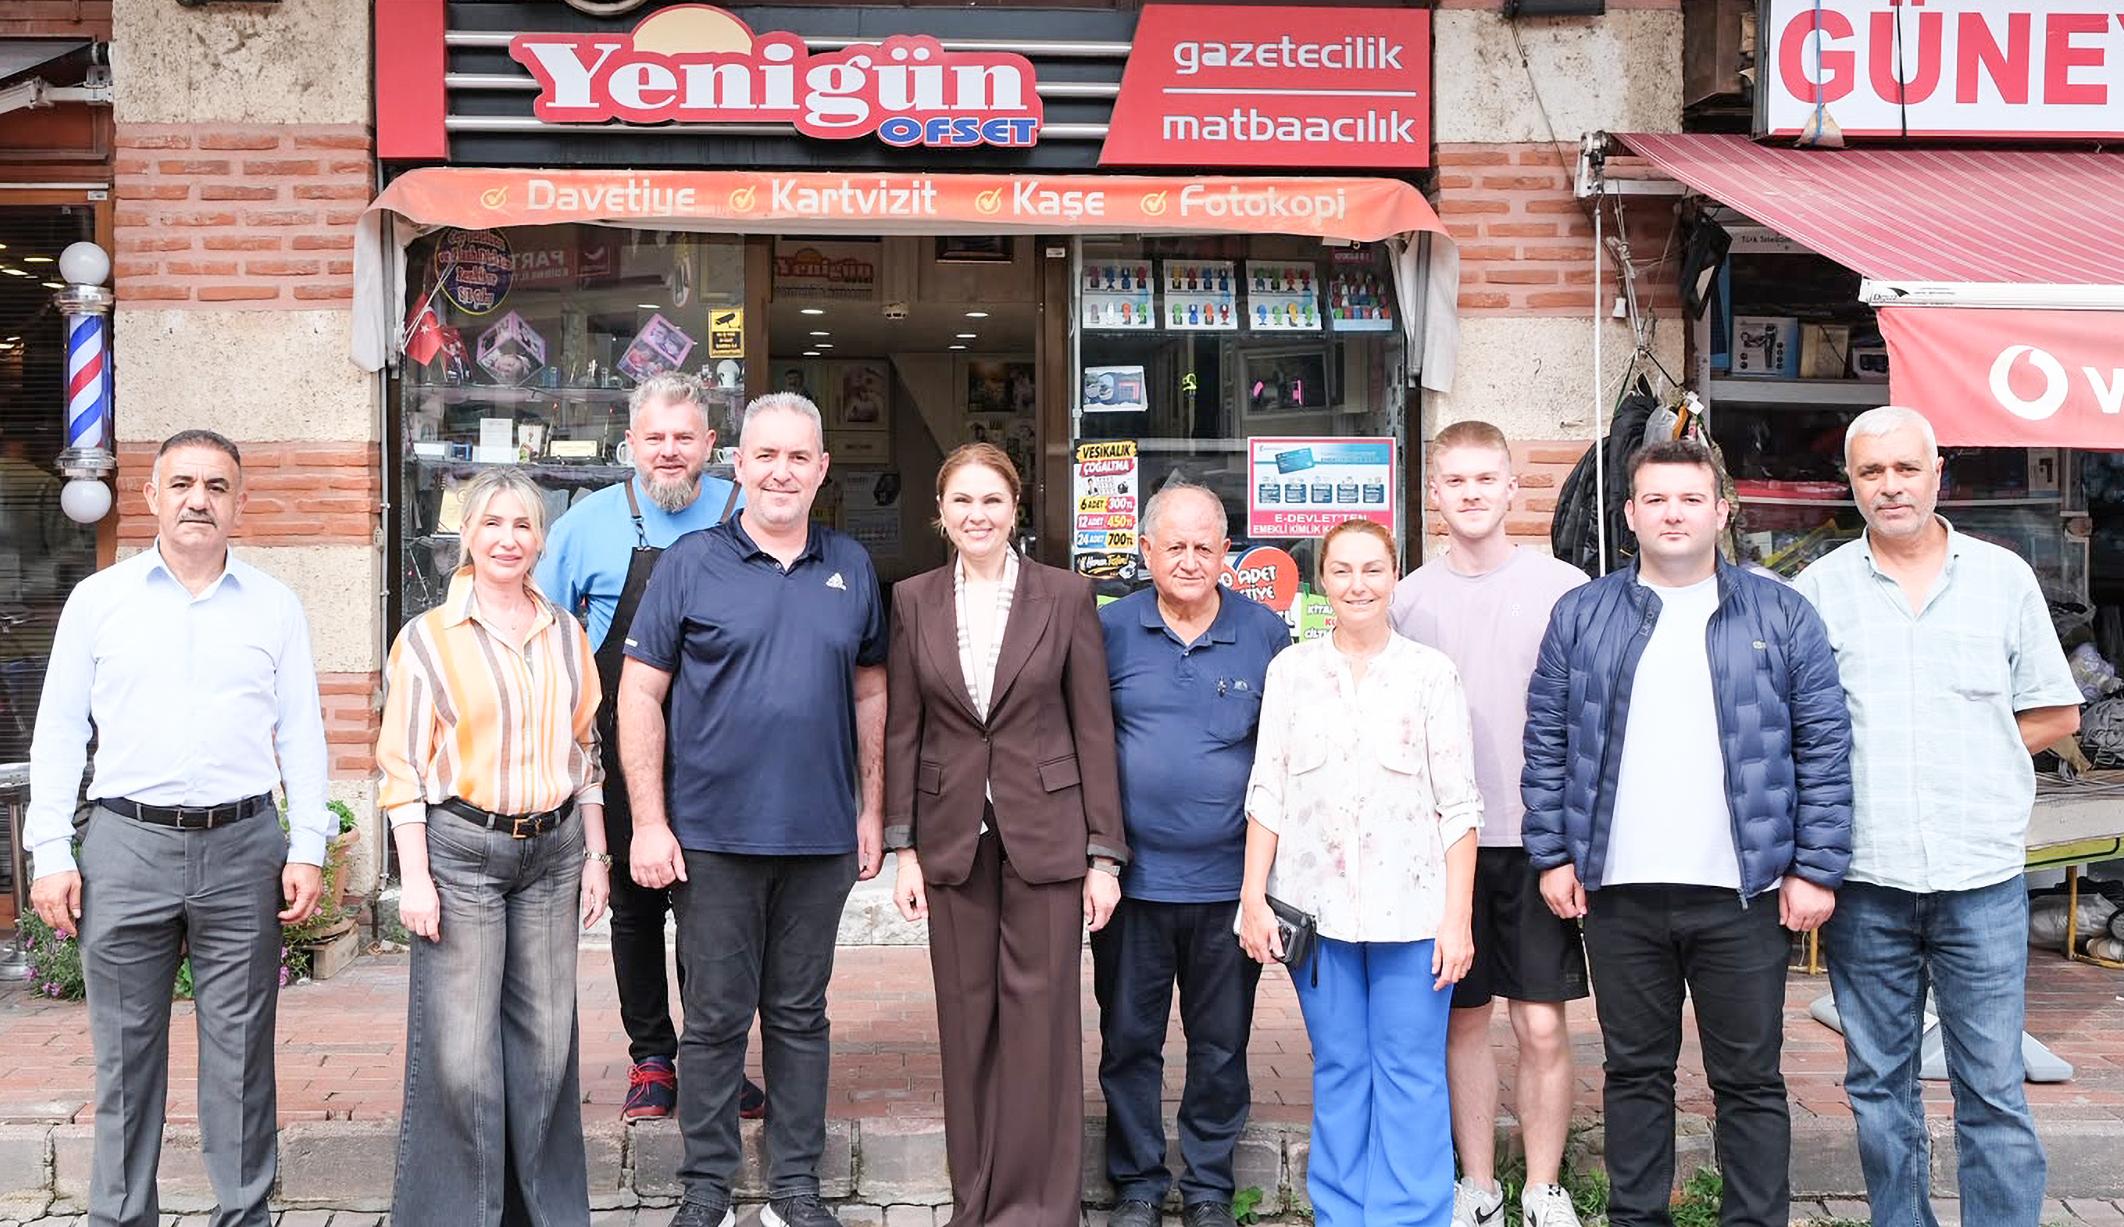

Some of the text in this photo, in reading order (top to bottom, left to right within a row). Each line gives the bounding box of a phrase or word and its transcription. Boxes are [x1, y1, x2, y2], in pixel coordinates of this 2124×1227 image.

[1173, 35, 1404, 75] gazetecilik
[1778, 0, 2124, 105] GÜNE
[522, 43, 1028, 128] Yenigün
[879, 117, 1038, 145] OFSET
[1162, 108, 1416, 144] matbaacılık
[528, 177, 1344, 221] Davetiye Kartvizit Kaşe Fotokopi
[1083, 444, 1131, 459] VESİKALIK
[1080, 499, 1087, 511] 6
[1238, 565, 1277, 585] ADET
